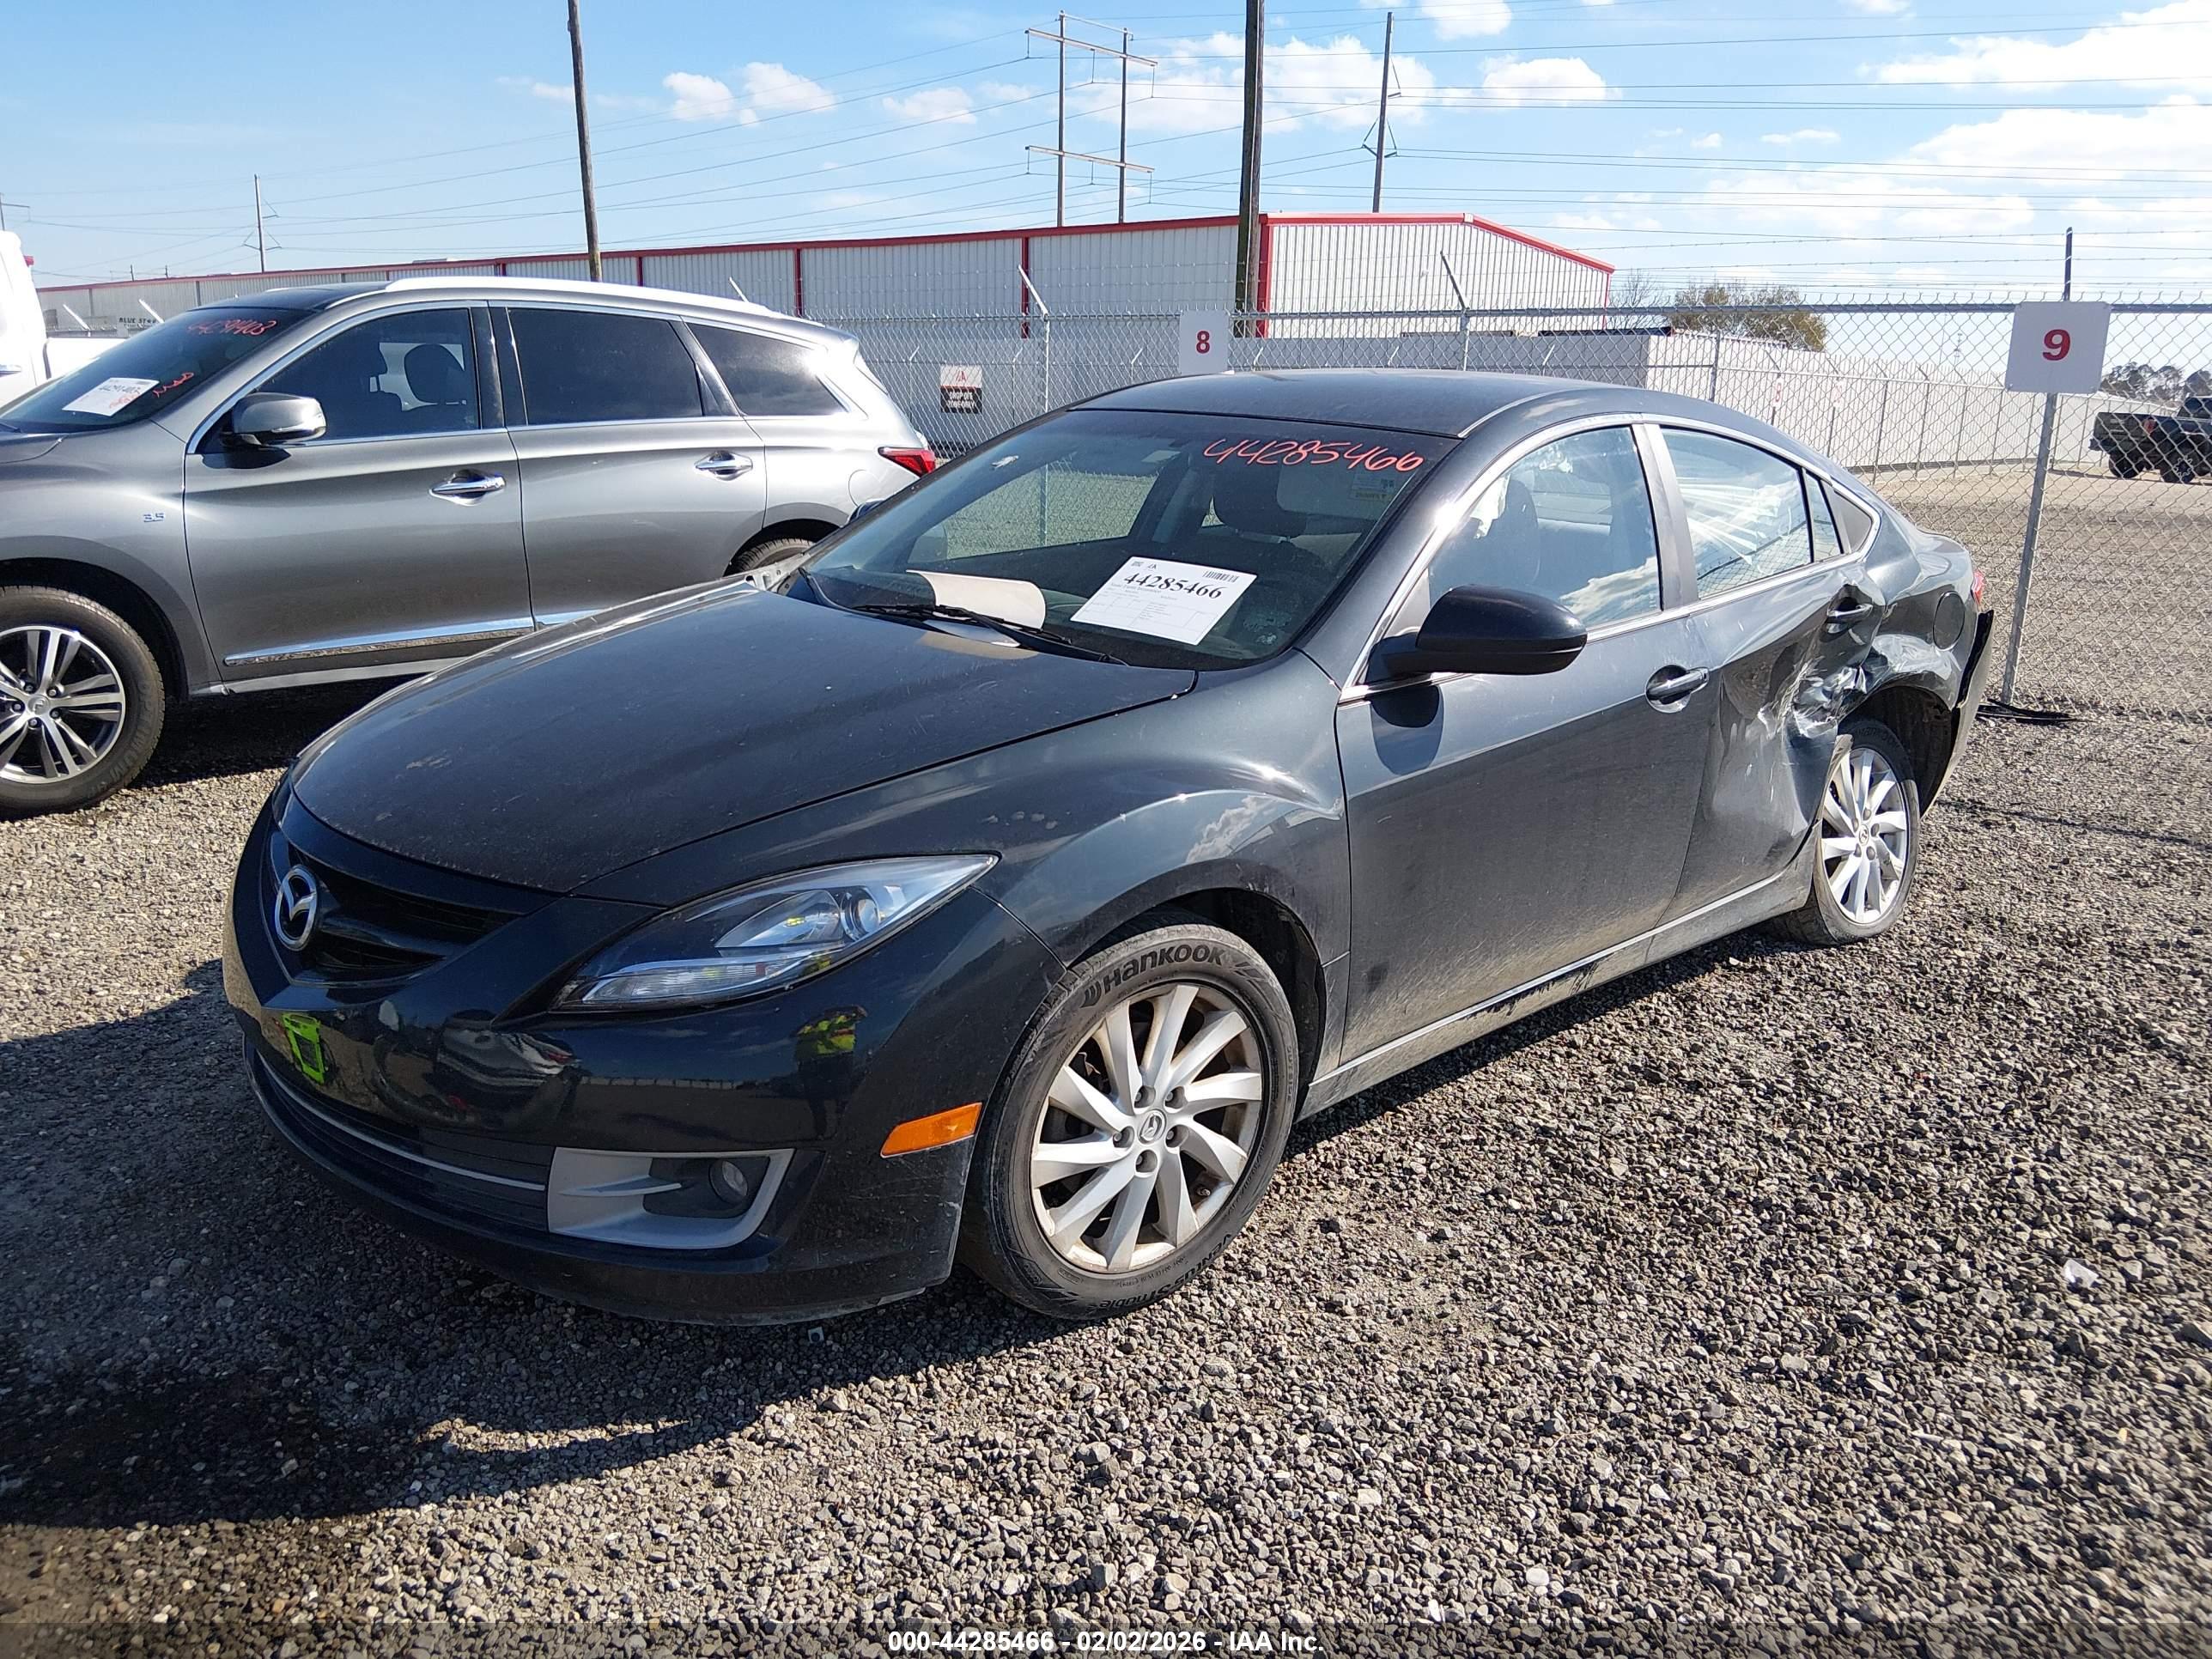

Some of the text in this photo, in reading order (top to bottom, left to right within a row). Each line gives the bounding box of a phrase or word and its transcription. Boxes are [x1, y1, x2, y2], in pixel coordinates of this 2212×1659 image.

[1195, 330, 1211, 354] 8
[2042, 329, 2071, 361] 9
[1203, 439, 1425, 471] 44285466
[1123, 572, 1227, 600] 44285466
